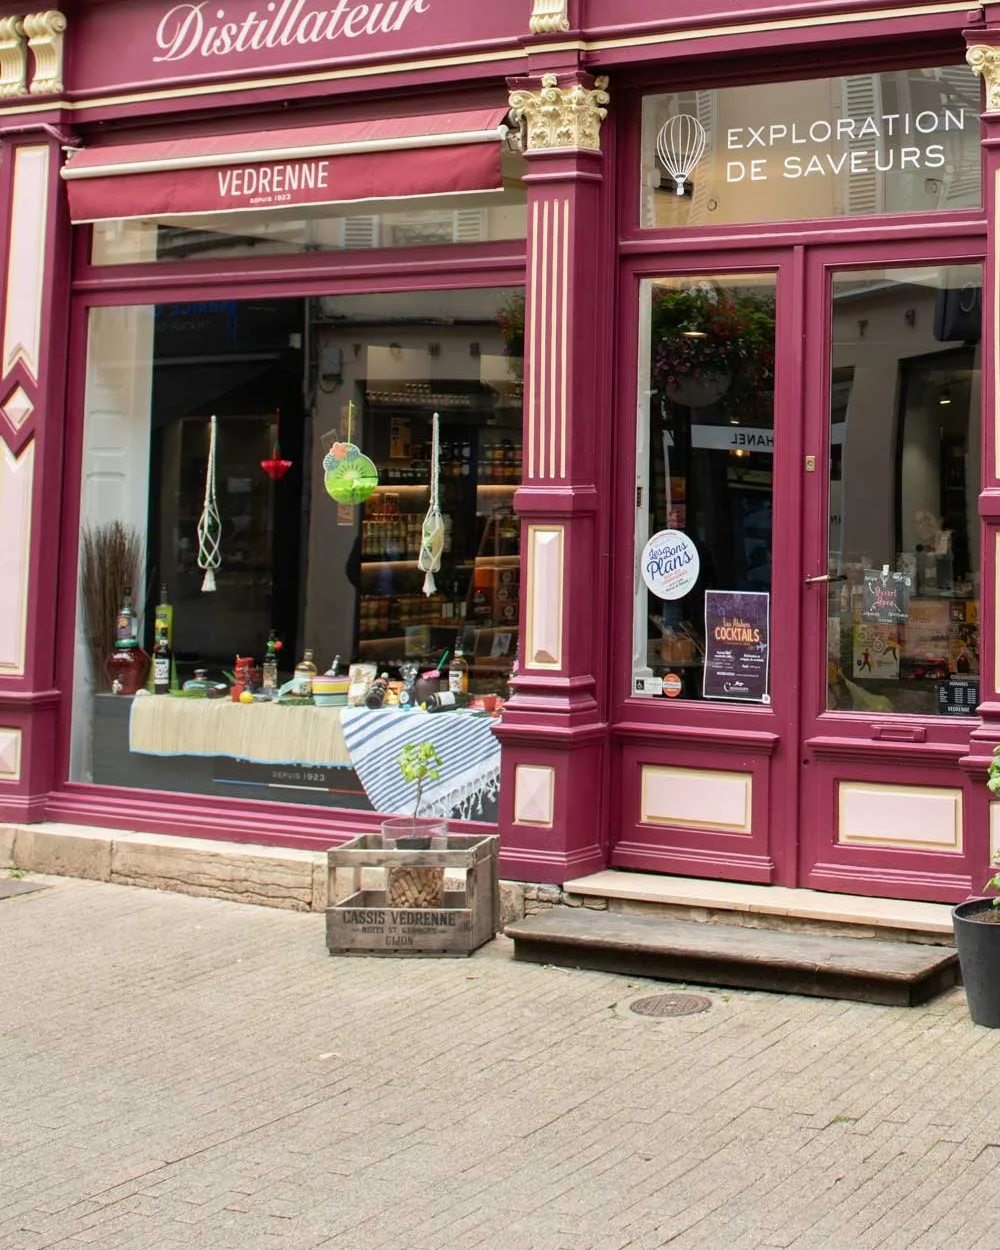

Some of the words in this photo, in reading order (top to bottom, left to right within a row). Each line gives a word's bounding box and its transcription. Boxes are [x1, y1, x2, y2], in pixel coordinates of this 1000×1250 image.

[727, 108, 965, 149] EXPLORATION
[726, 159, 768, 183] DE
[783, 144, 945, 178] SAVEURS
[217, 161, 329, 197] VEDRENNE
[249, 196, 273, 204] DEPUIS
[648, 548, 663, 561] Les
[663, 542, 688, 560] Bons
[646, 550, 694, 581] Plans
[714, 626, 760, 643] COCKTAILS
[303, 772, 325, 782] 1923
[342, 910, 386, 925] CASSIS
[391, 911, 457, 927] VEDRENNE
